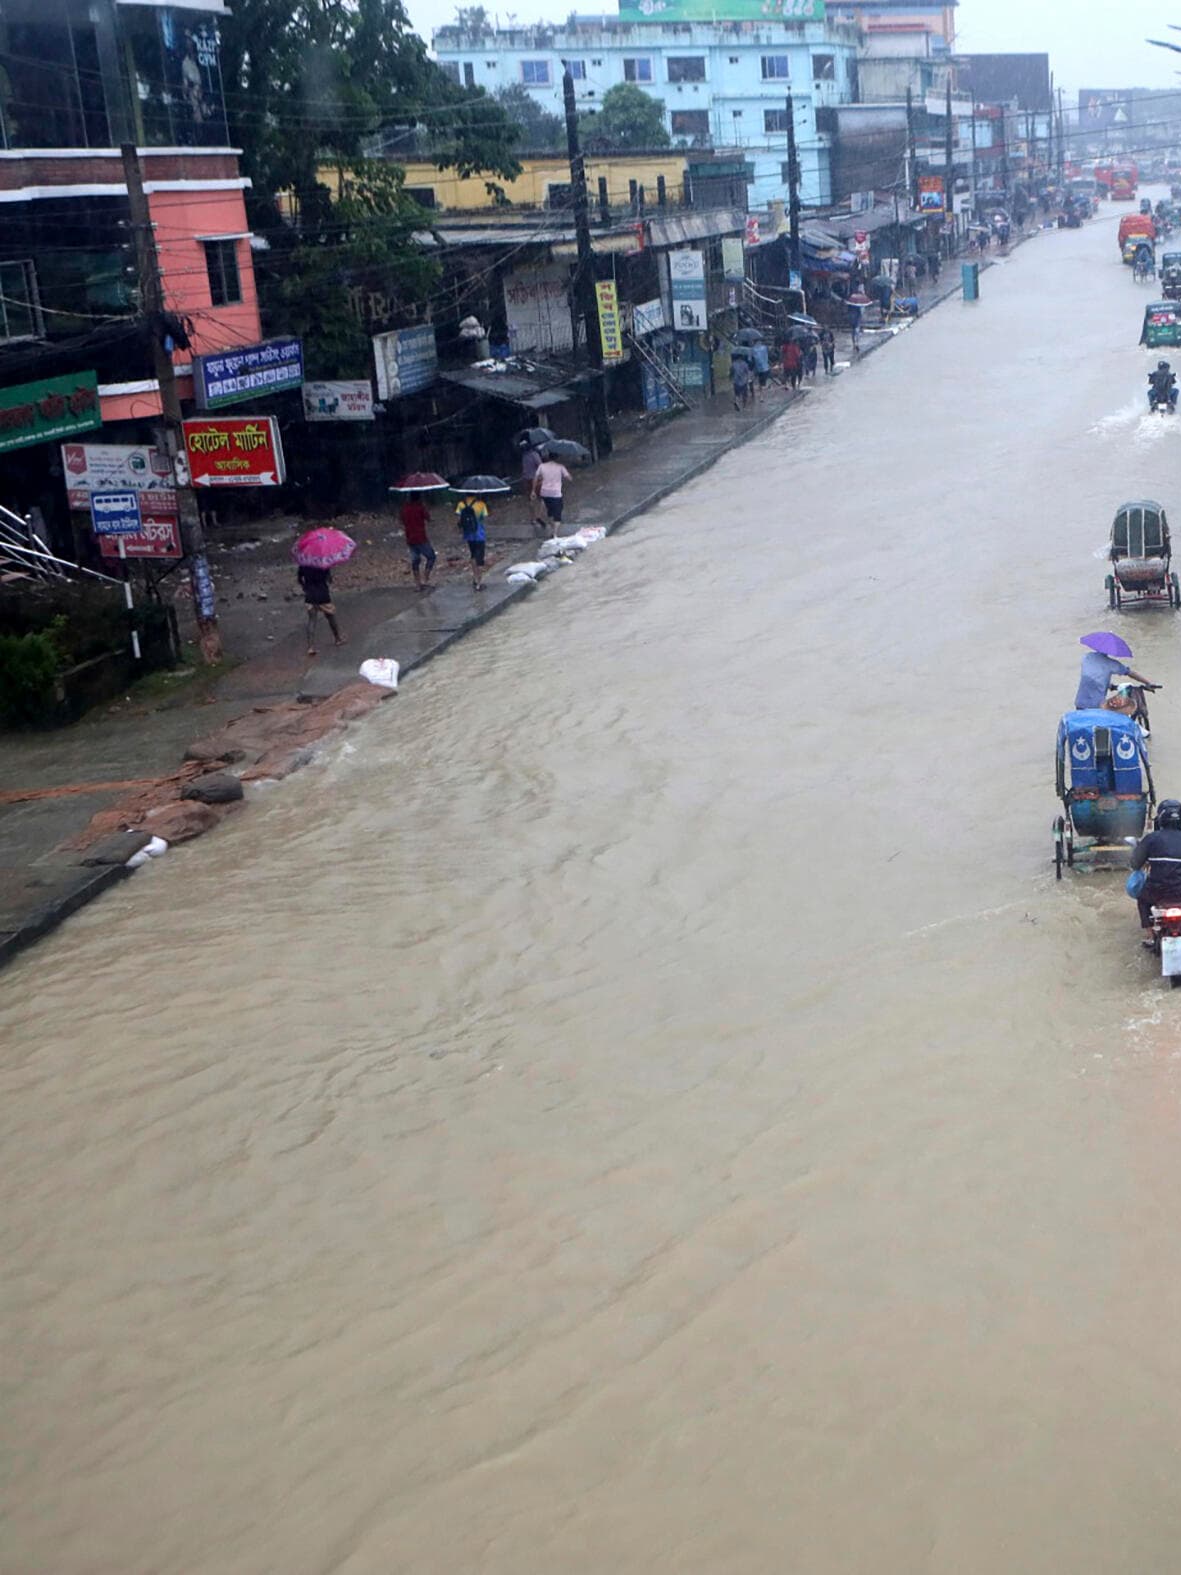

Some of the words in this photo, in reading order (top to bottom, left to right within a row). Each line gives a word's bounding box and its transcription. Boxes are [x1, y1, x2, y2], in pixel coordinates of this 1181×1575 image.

[189, 426, 230, 455] হোটেল
[232, 423, 270, 451] মার্টিন
[214, 456, 251, 471] আবাসিক
